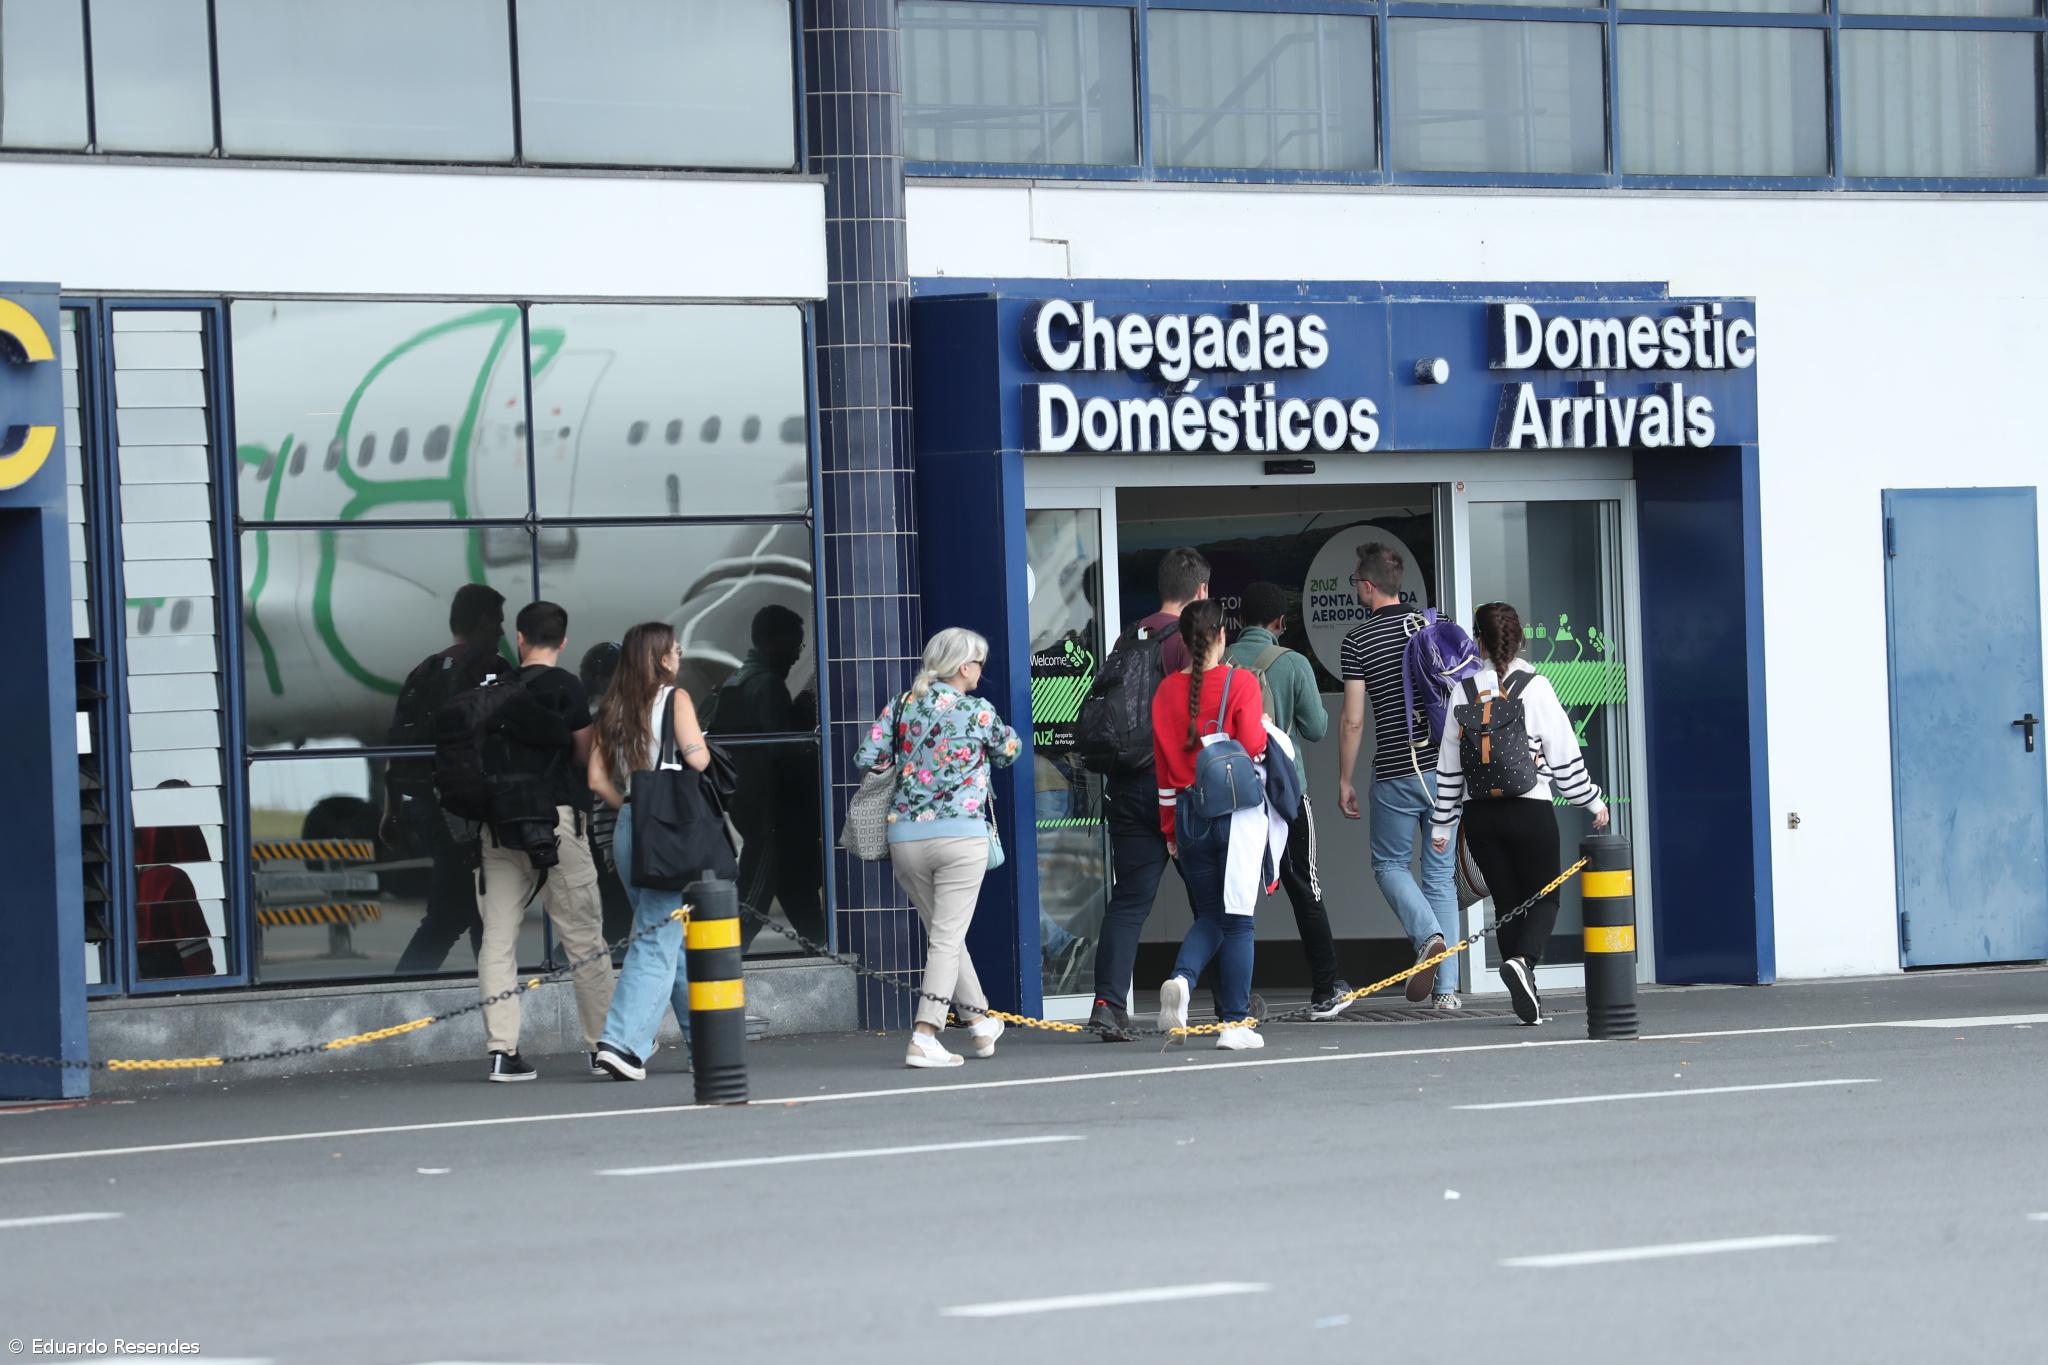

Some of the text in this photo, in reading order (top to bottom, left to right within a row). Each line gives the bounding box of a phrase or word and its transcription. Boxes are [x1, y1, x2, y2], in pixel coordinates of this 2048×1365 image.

[1035, 299, 1329, 378] Chegadas
[1503, 303, 1756, 370] Domestic
[1038, 378, 1379, 452] Domésticos
[1509, 382, 1715, 449] Arrivals
[1311, 594, 1354, 607] PONTA
[1312, 608, 1372, 622] AEROPOR
